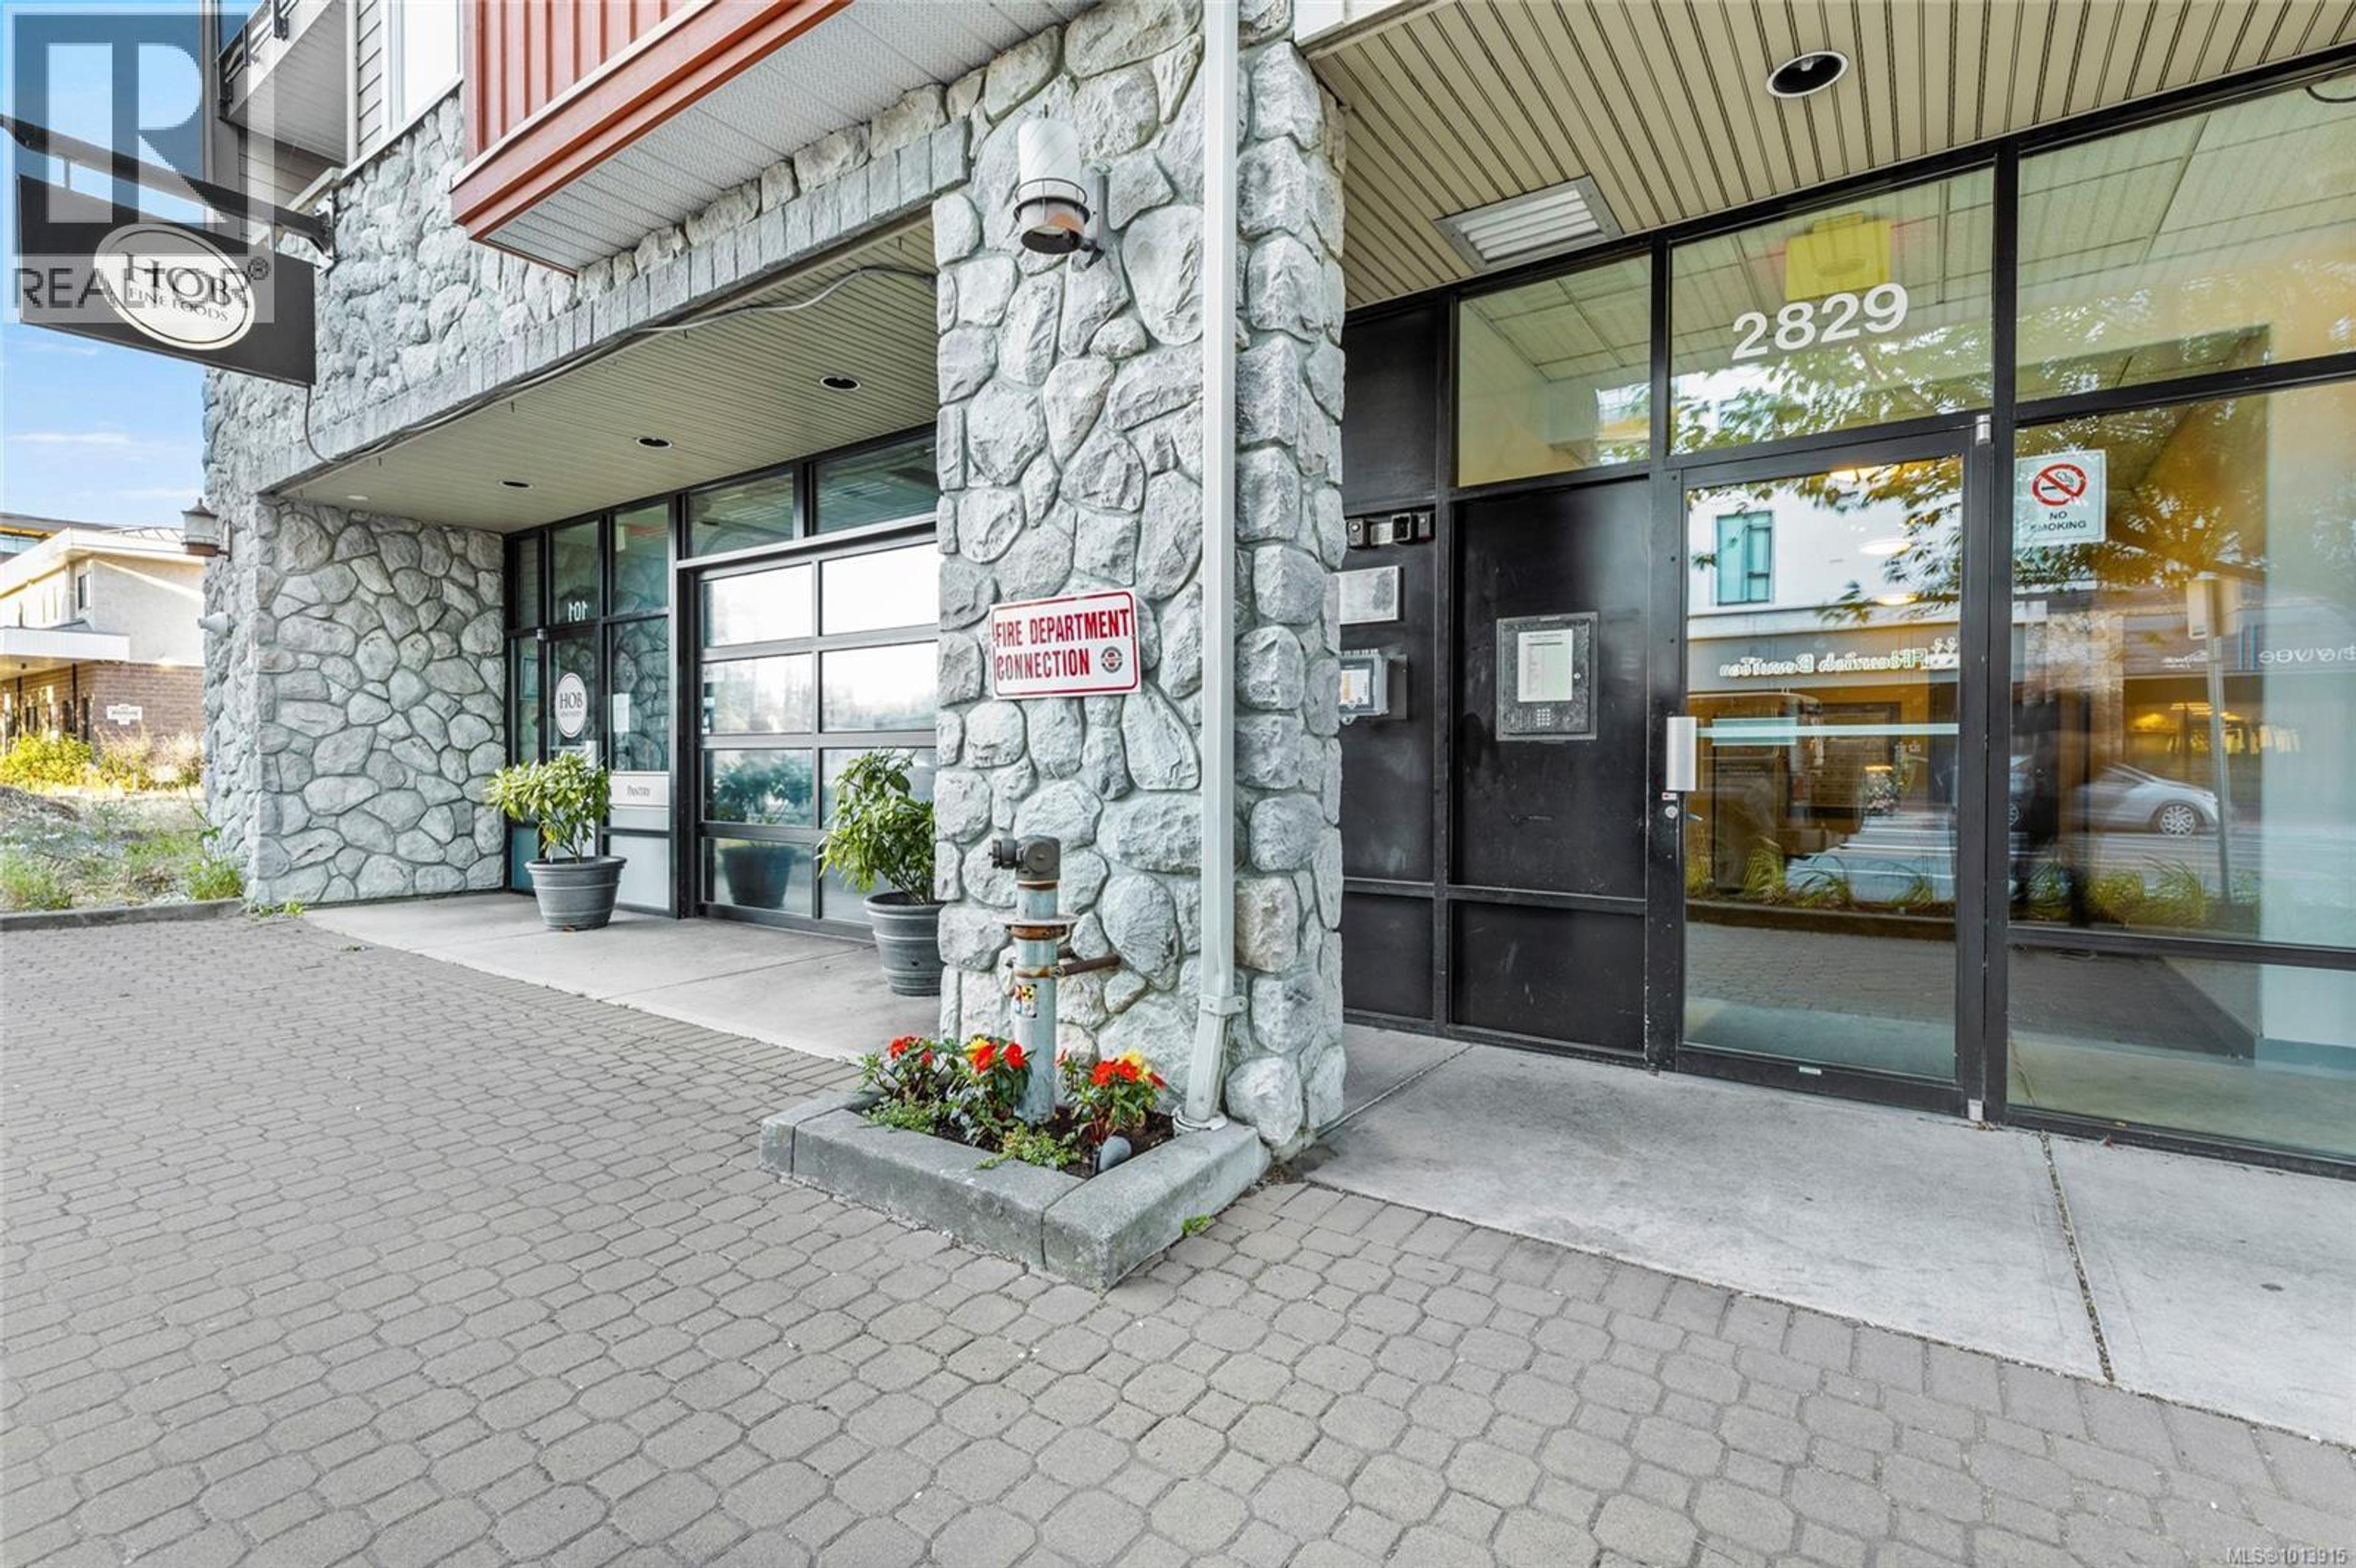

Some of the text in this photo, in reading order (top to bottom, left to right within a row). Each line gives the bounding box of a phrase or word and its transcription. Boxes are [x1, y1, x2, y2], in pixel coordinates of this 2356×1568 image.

[125, 252, 234, 307] HOB
[129, 288, 229, 323] FINE FOODS
[1731, 283, 1908, 361] 2829
[2049, 510, 2067, 520] NO
[996, 608, 1130, 648] FIRE DEPARTMENT
[996, 647, 1090, 681] CONNECTION
[559, 691, 583, 709] HOB
